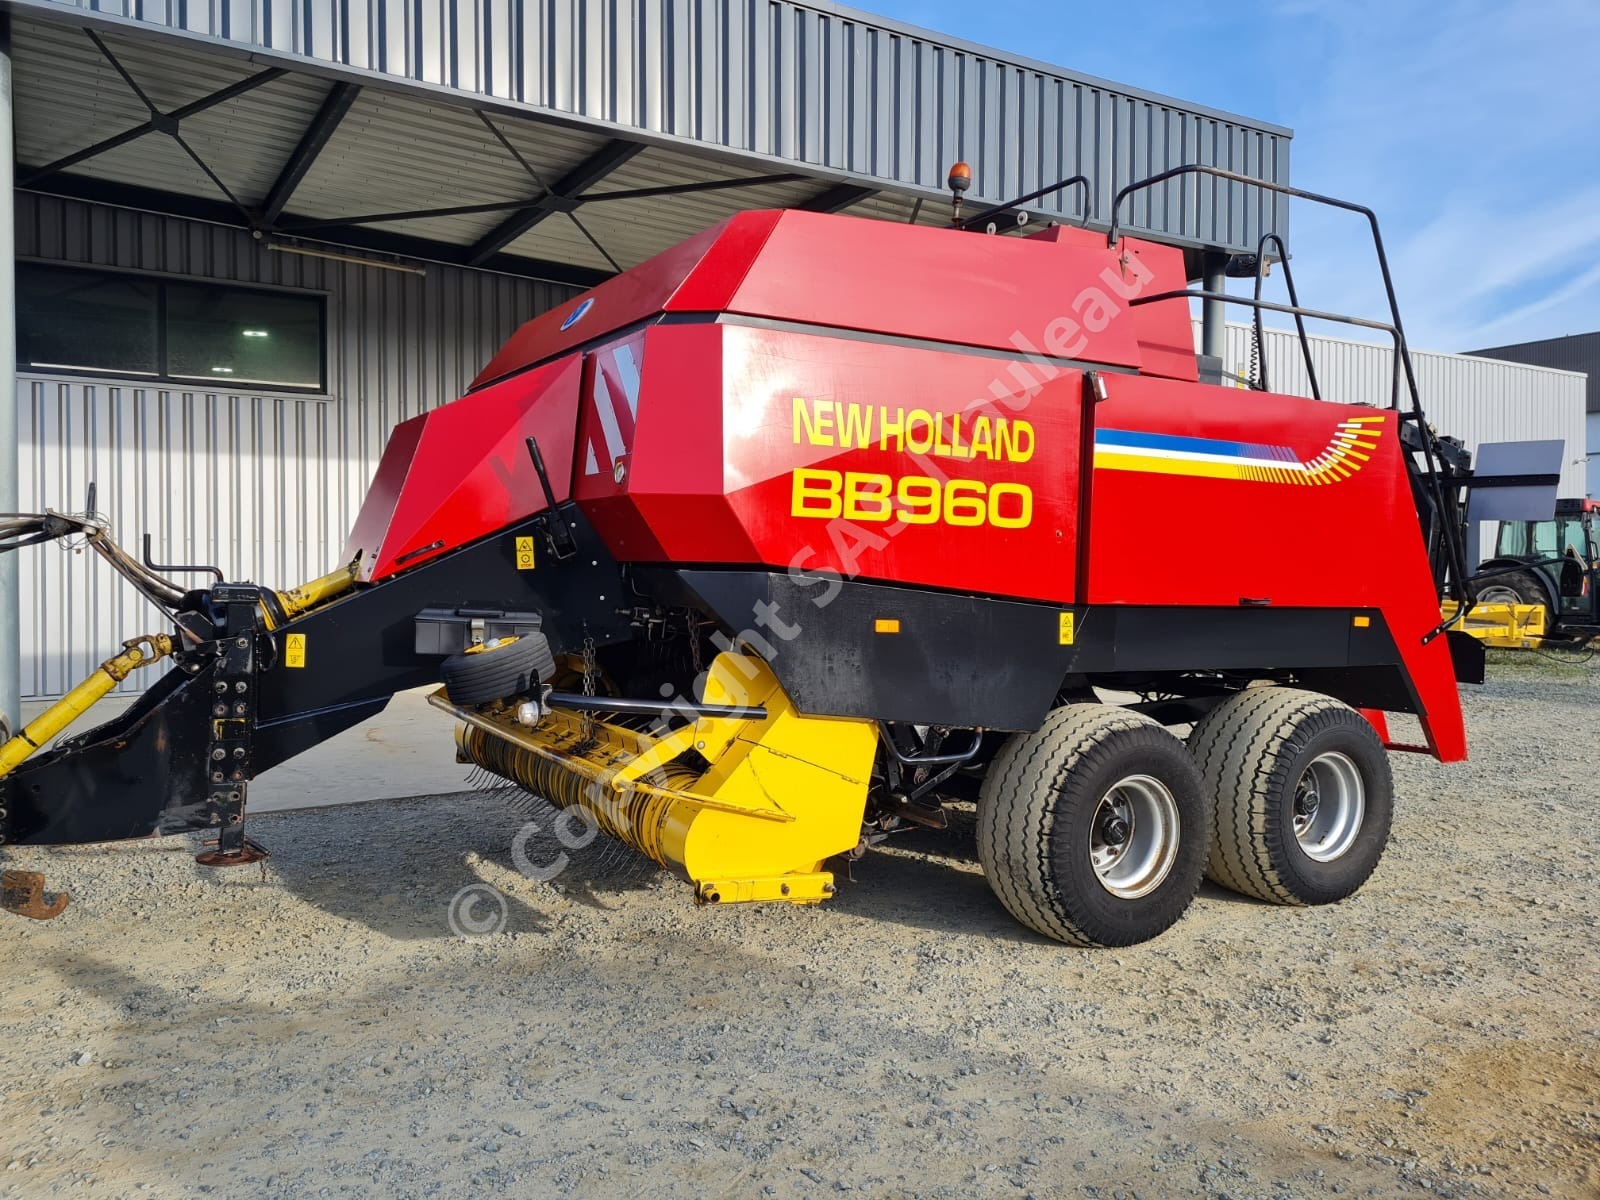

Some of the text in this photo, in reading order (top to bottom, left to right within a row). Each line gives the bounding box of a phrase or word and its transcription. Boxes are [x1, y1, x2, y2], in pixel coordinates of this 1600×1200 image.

[792, 397, 1035, 463] NEW HOLLAND
[790, 467, 1033, 529] BB960
